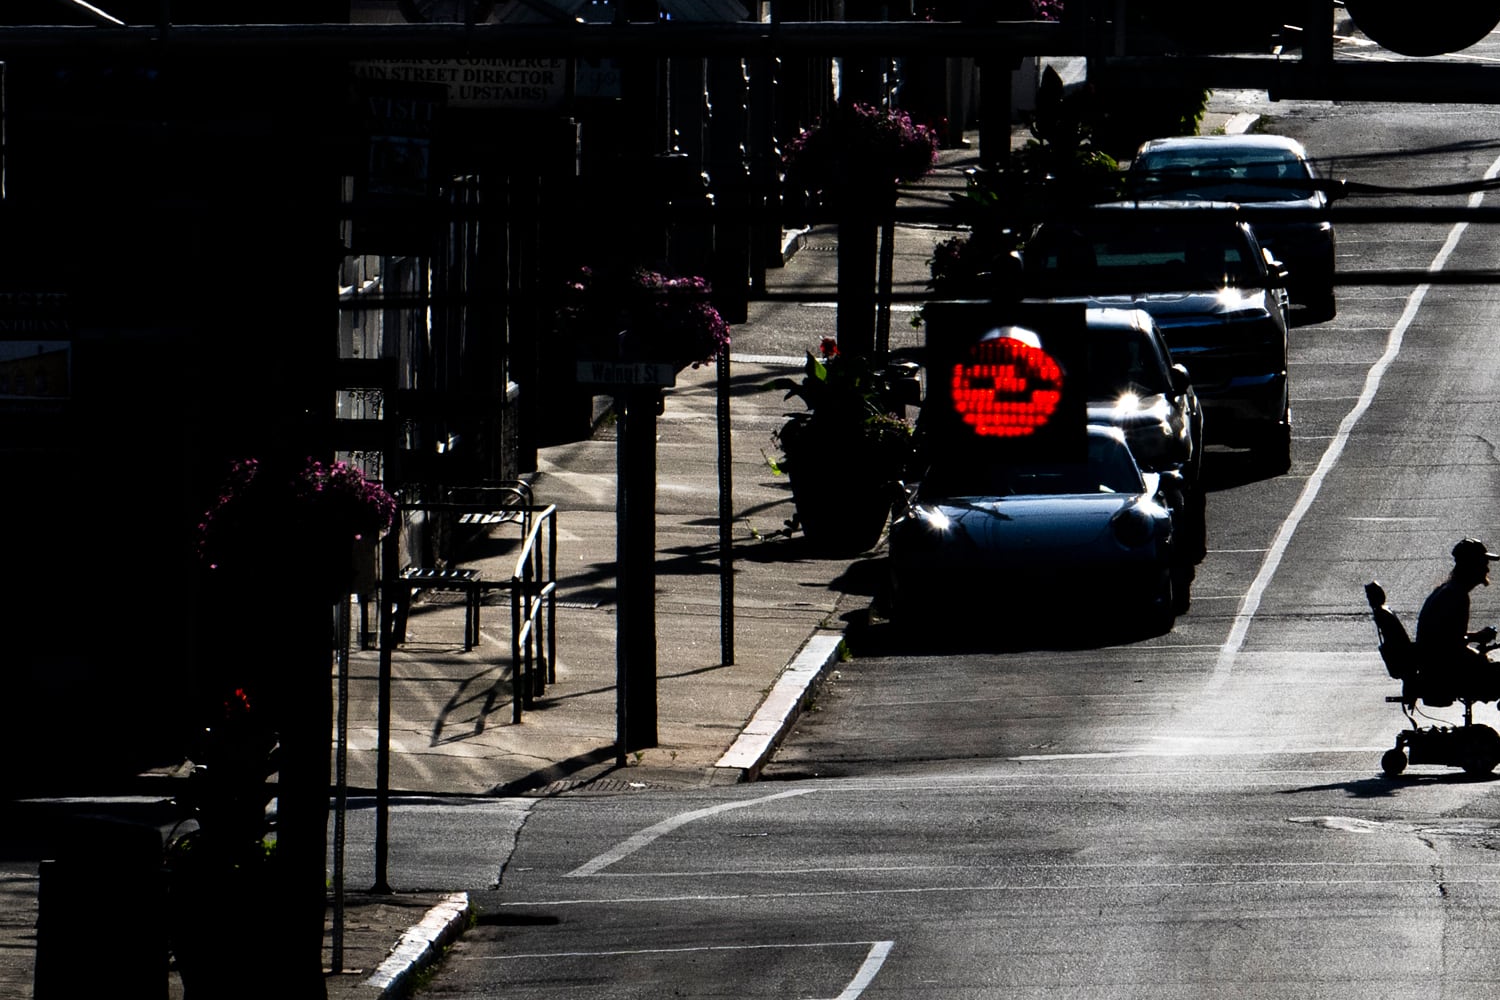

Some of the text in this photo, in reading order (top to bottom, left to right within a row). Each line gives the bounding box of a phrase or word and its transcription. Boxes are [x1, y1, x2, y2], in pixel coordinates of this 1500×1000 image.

[391, 67, 458, 83] STREET
[464, 69, 555, 85] DIRECTOR
[592, 363, 660, 384] Walnut St
